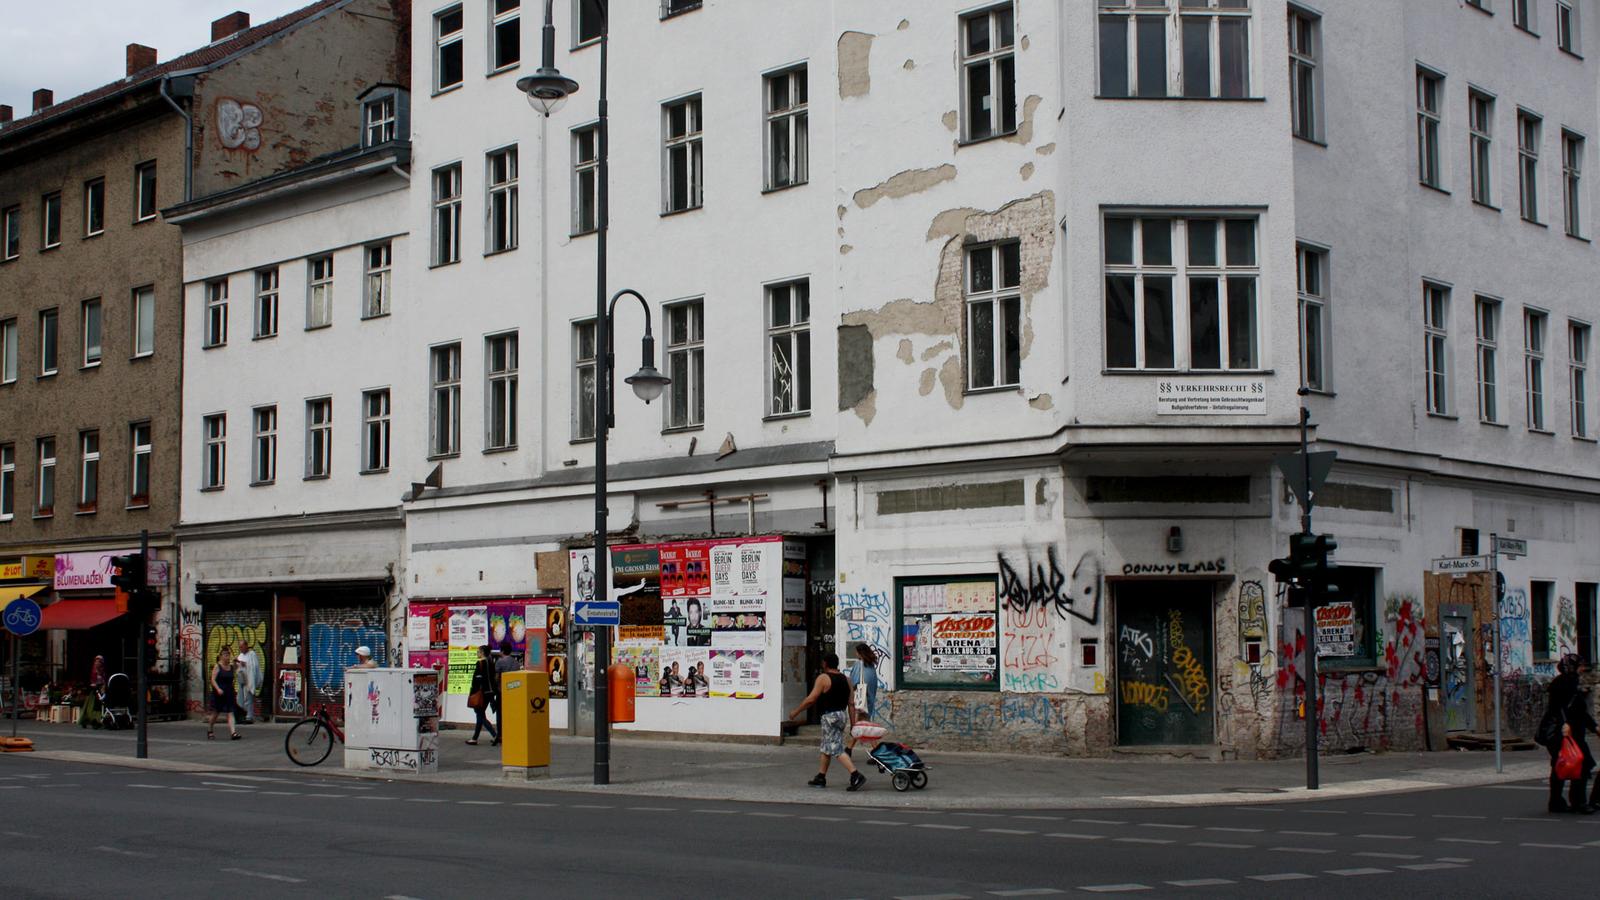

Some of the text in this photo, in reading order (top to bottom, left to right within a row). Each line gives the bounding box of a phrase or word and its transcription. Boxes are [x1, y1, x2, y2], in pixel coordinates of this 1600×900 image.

[714, 555, 732, 564] BERLIN
[741, 554, 761, 563] BERLIN
[714, 563, 731, 573] QUEER
[741, 563, 760, 572] QUEER
[1438, 559, 1481, 569] Karl-Marx-Str.
[57, 571, 104, 586] BLUMENLADEN
[714, 572, 729, 581] DAYS
[741, 571, 757, 580] DAYS
[933, 616, 995, 632] TATTOO
[946, 639, 981, 647] ARENA
[961, 647, 975, 655] AUG.
